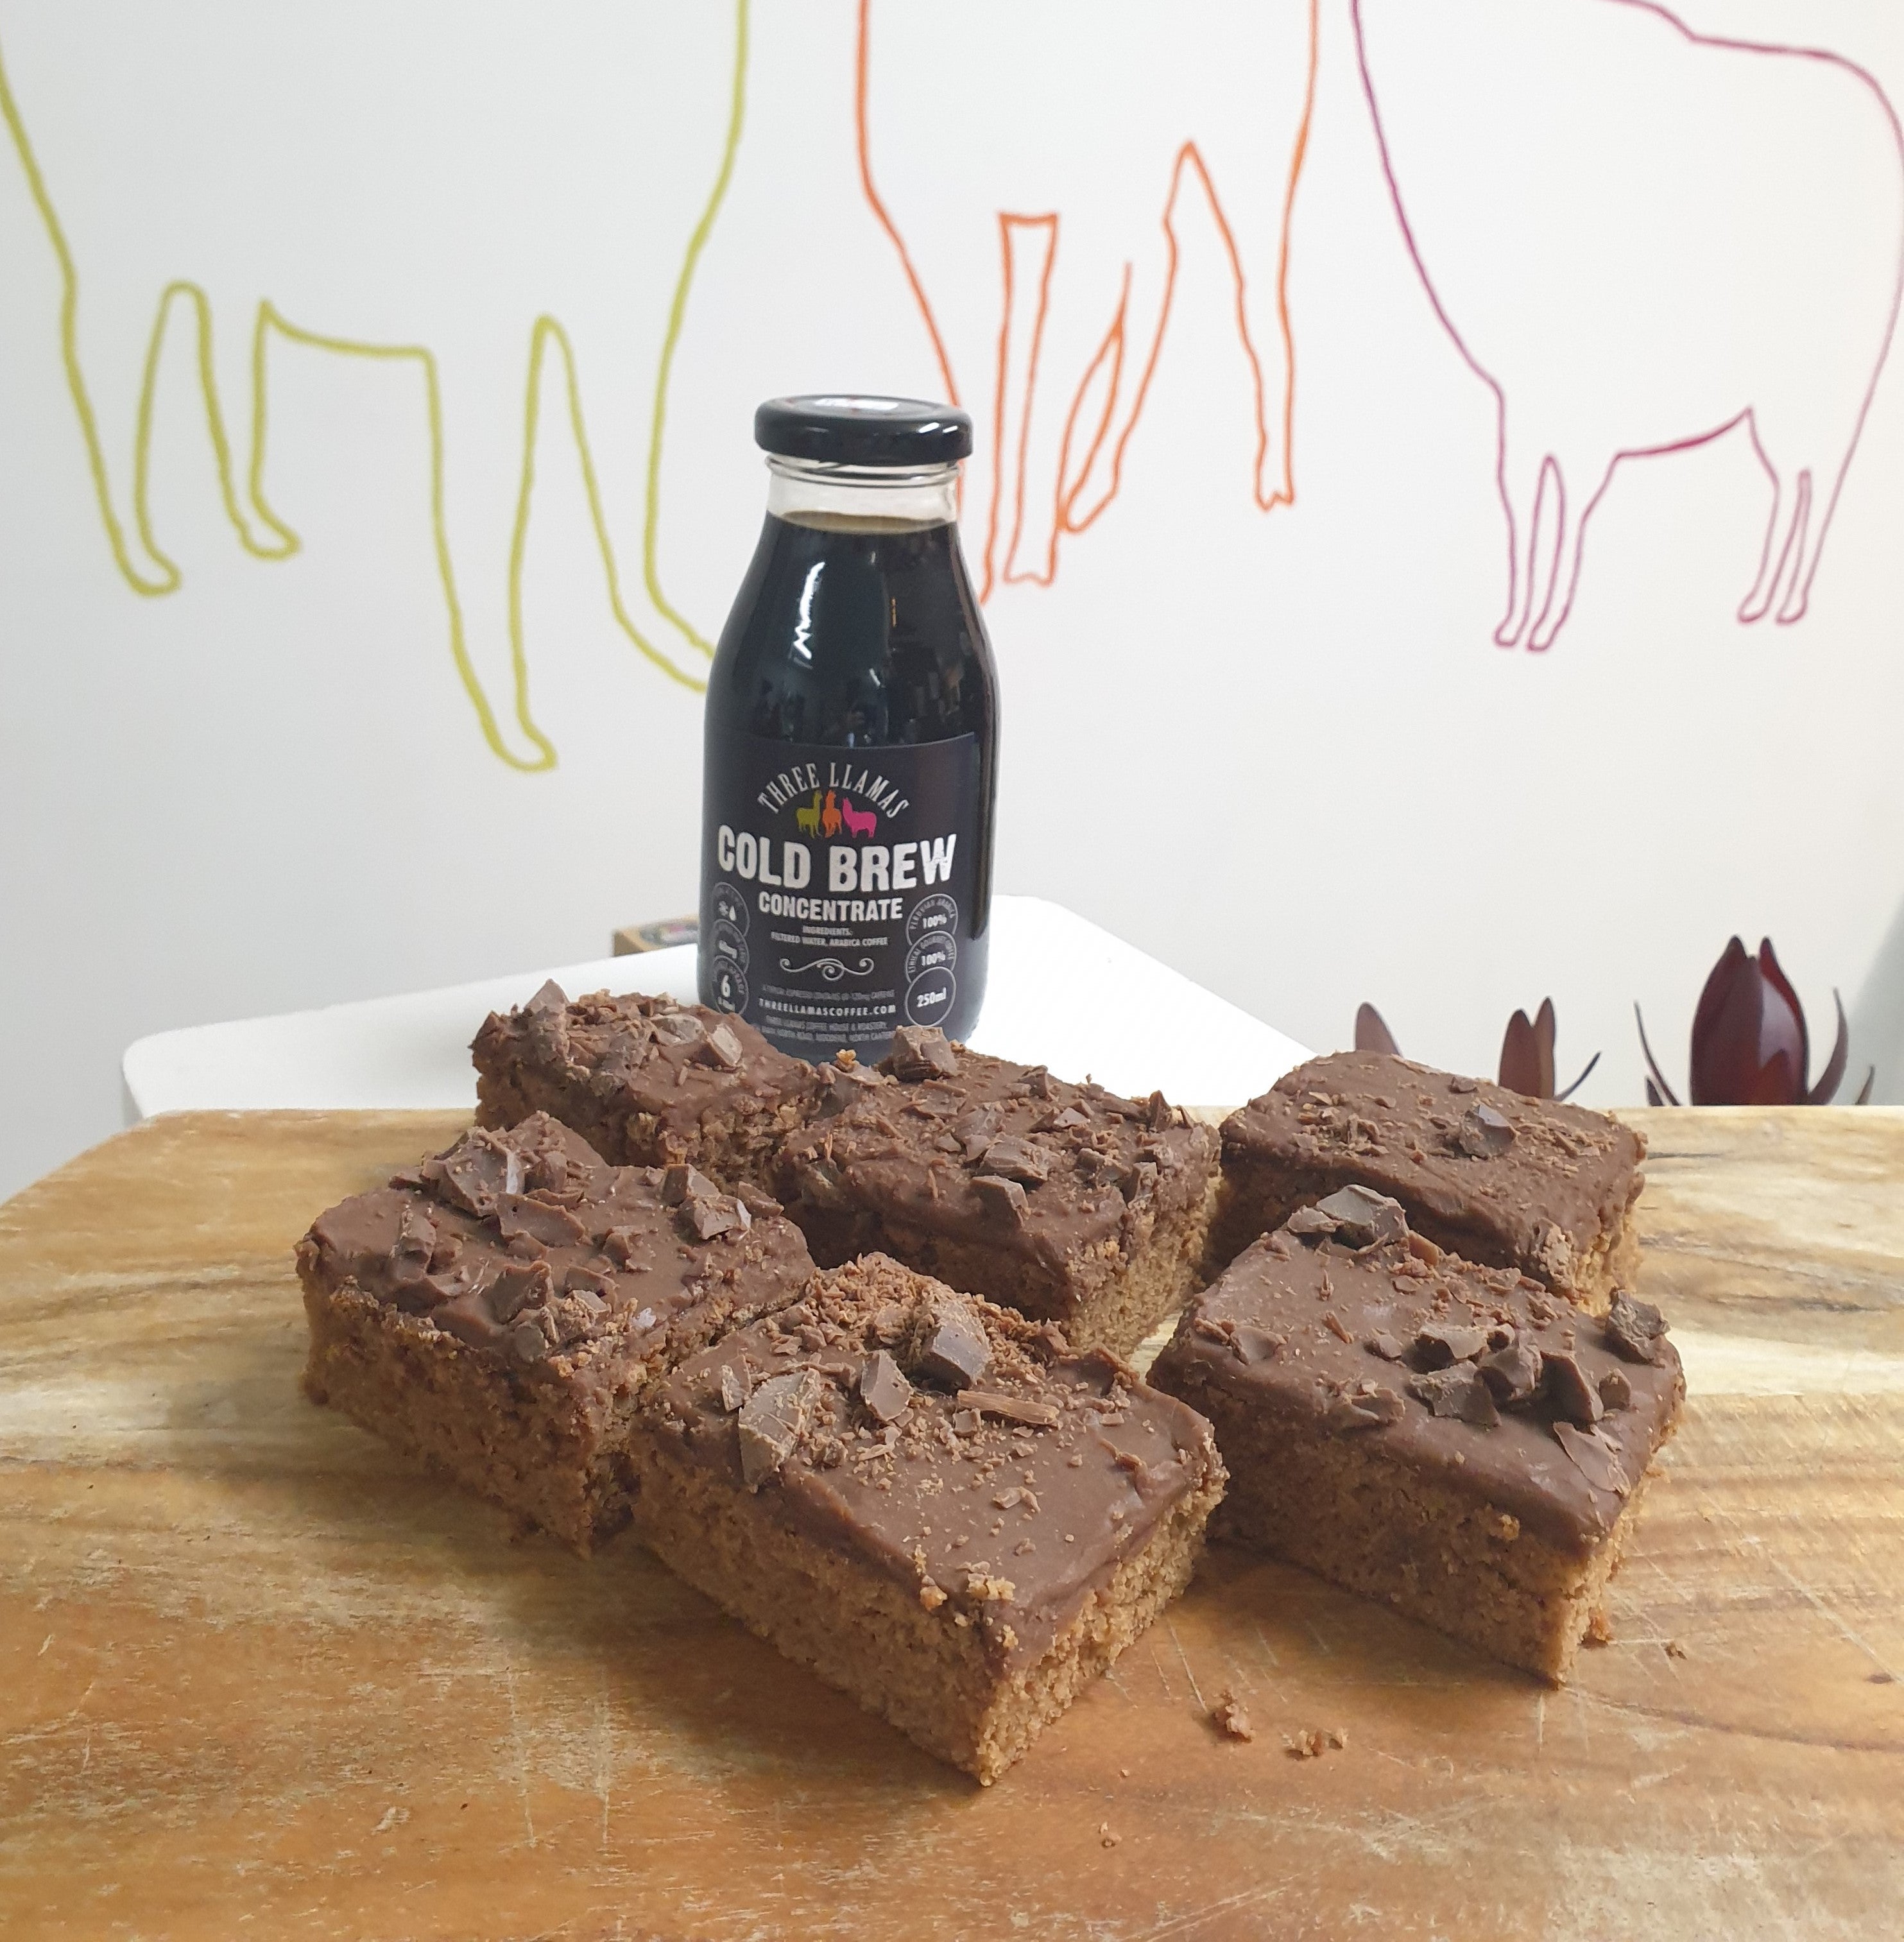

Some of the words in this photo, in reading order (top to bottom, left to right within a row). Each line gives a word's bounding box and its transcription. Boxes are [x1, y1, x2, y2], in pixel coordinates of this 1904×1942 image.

[757, 762, 820, 814] THREE
[828, 762, 910, 818] LLAMAS
[717, 824, 811, 889] COLD
[828, 833, 957, 892] BREW
[759, 891, 904, 922] CONCENTRATE
[922, 913, 947, 929] 100%
[862, 936, 889, 947] COFFEE
[921, 950, 946, 967] 100%
[721, 974, 731, 998] 6
[916, 986, 947, 1008] 250ml
[759, 997, 896, 1017] THREELLAMASCOFFEE.COM
